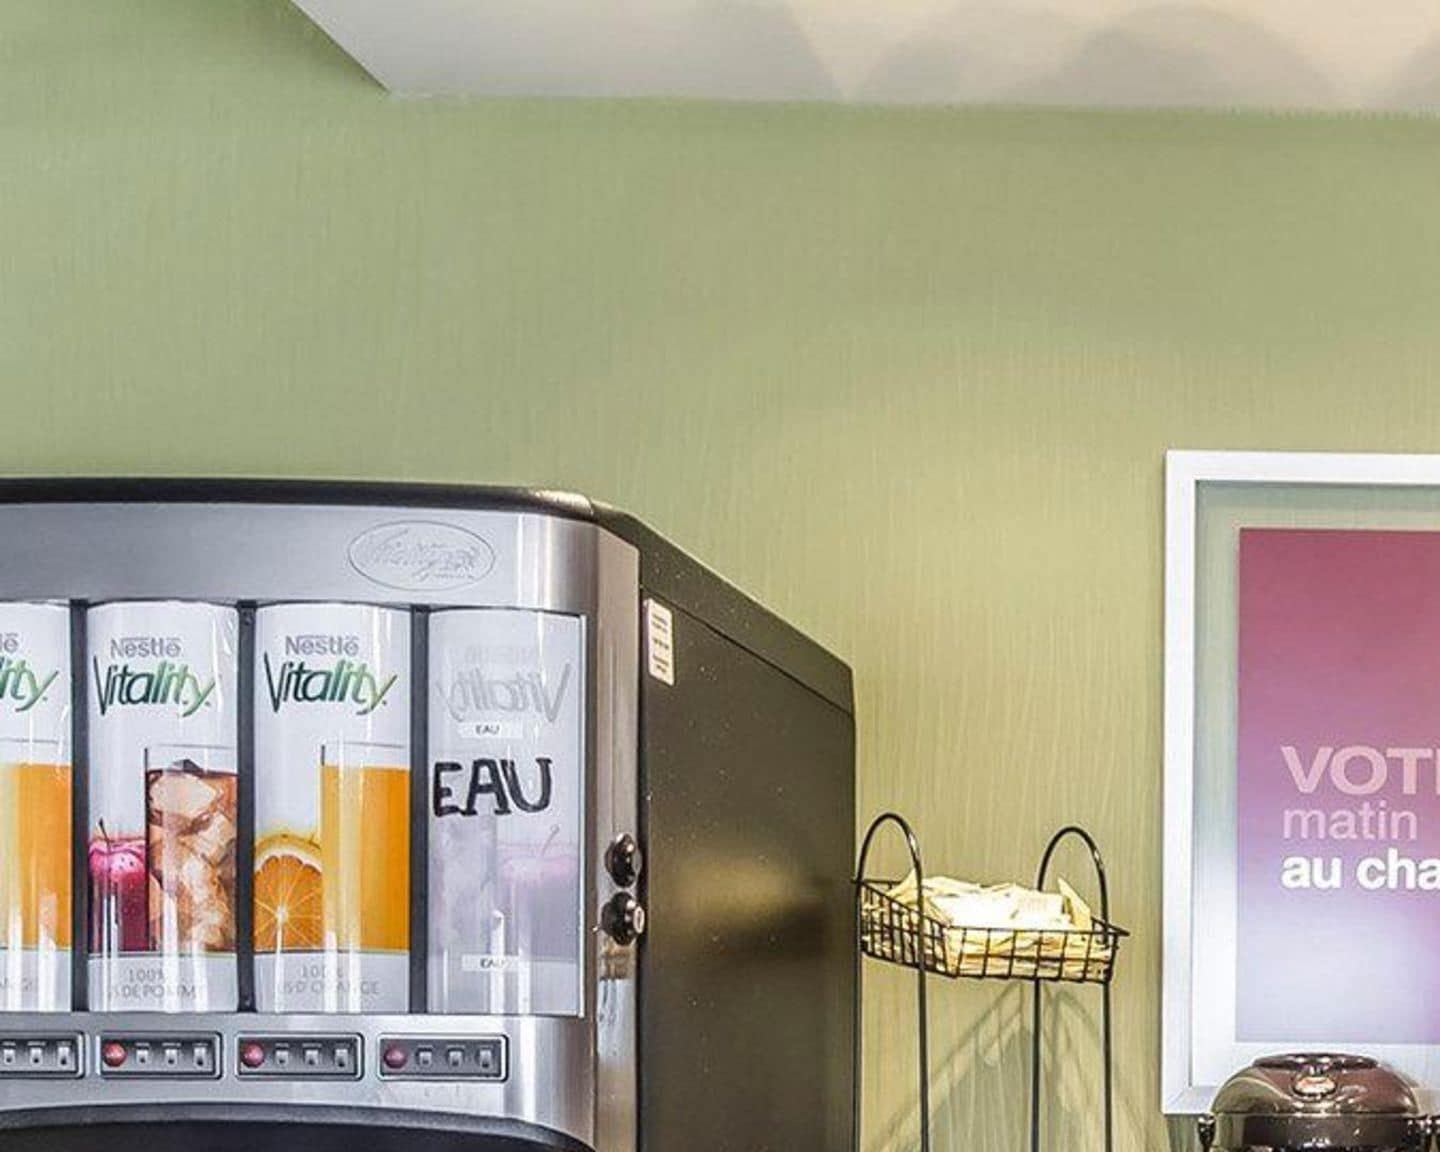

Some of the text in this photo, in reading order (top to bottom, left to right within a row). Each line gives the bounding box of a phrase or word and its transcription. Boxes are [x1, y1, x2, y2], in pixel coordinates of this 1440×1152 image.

[93, 655, 216, 717] Vitality
[264, 651, 398, 716] Vitality
[475, 724, 500, 735] EAU
[432, 756, 554, 818] EAU
[1283, 800, 1418, 840] matin
[1280, 855, 1342, 889] au
